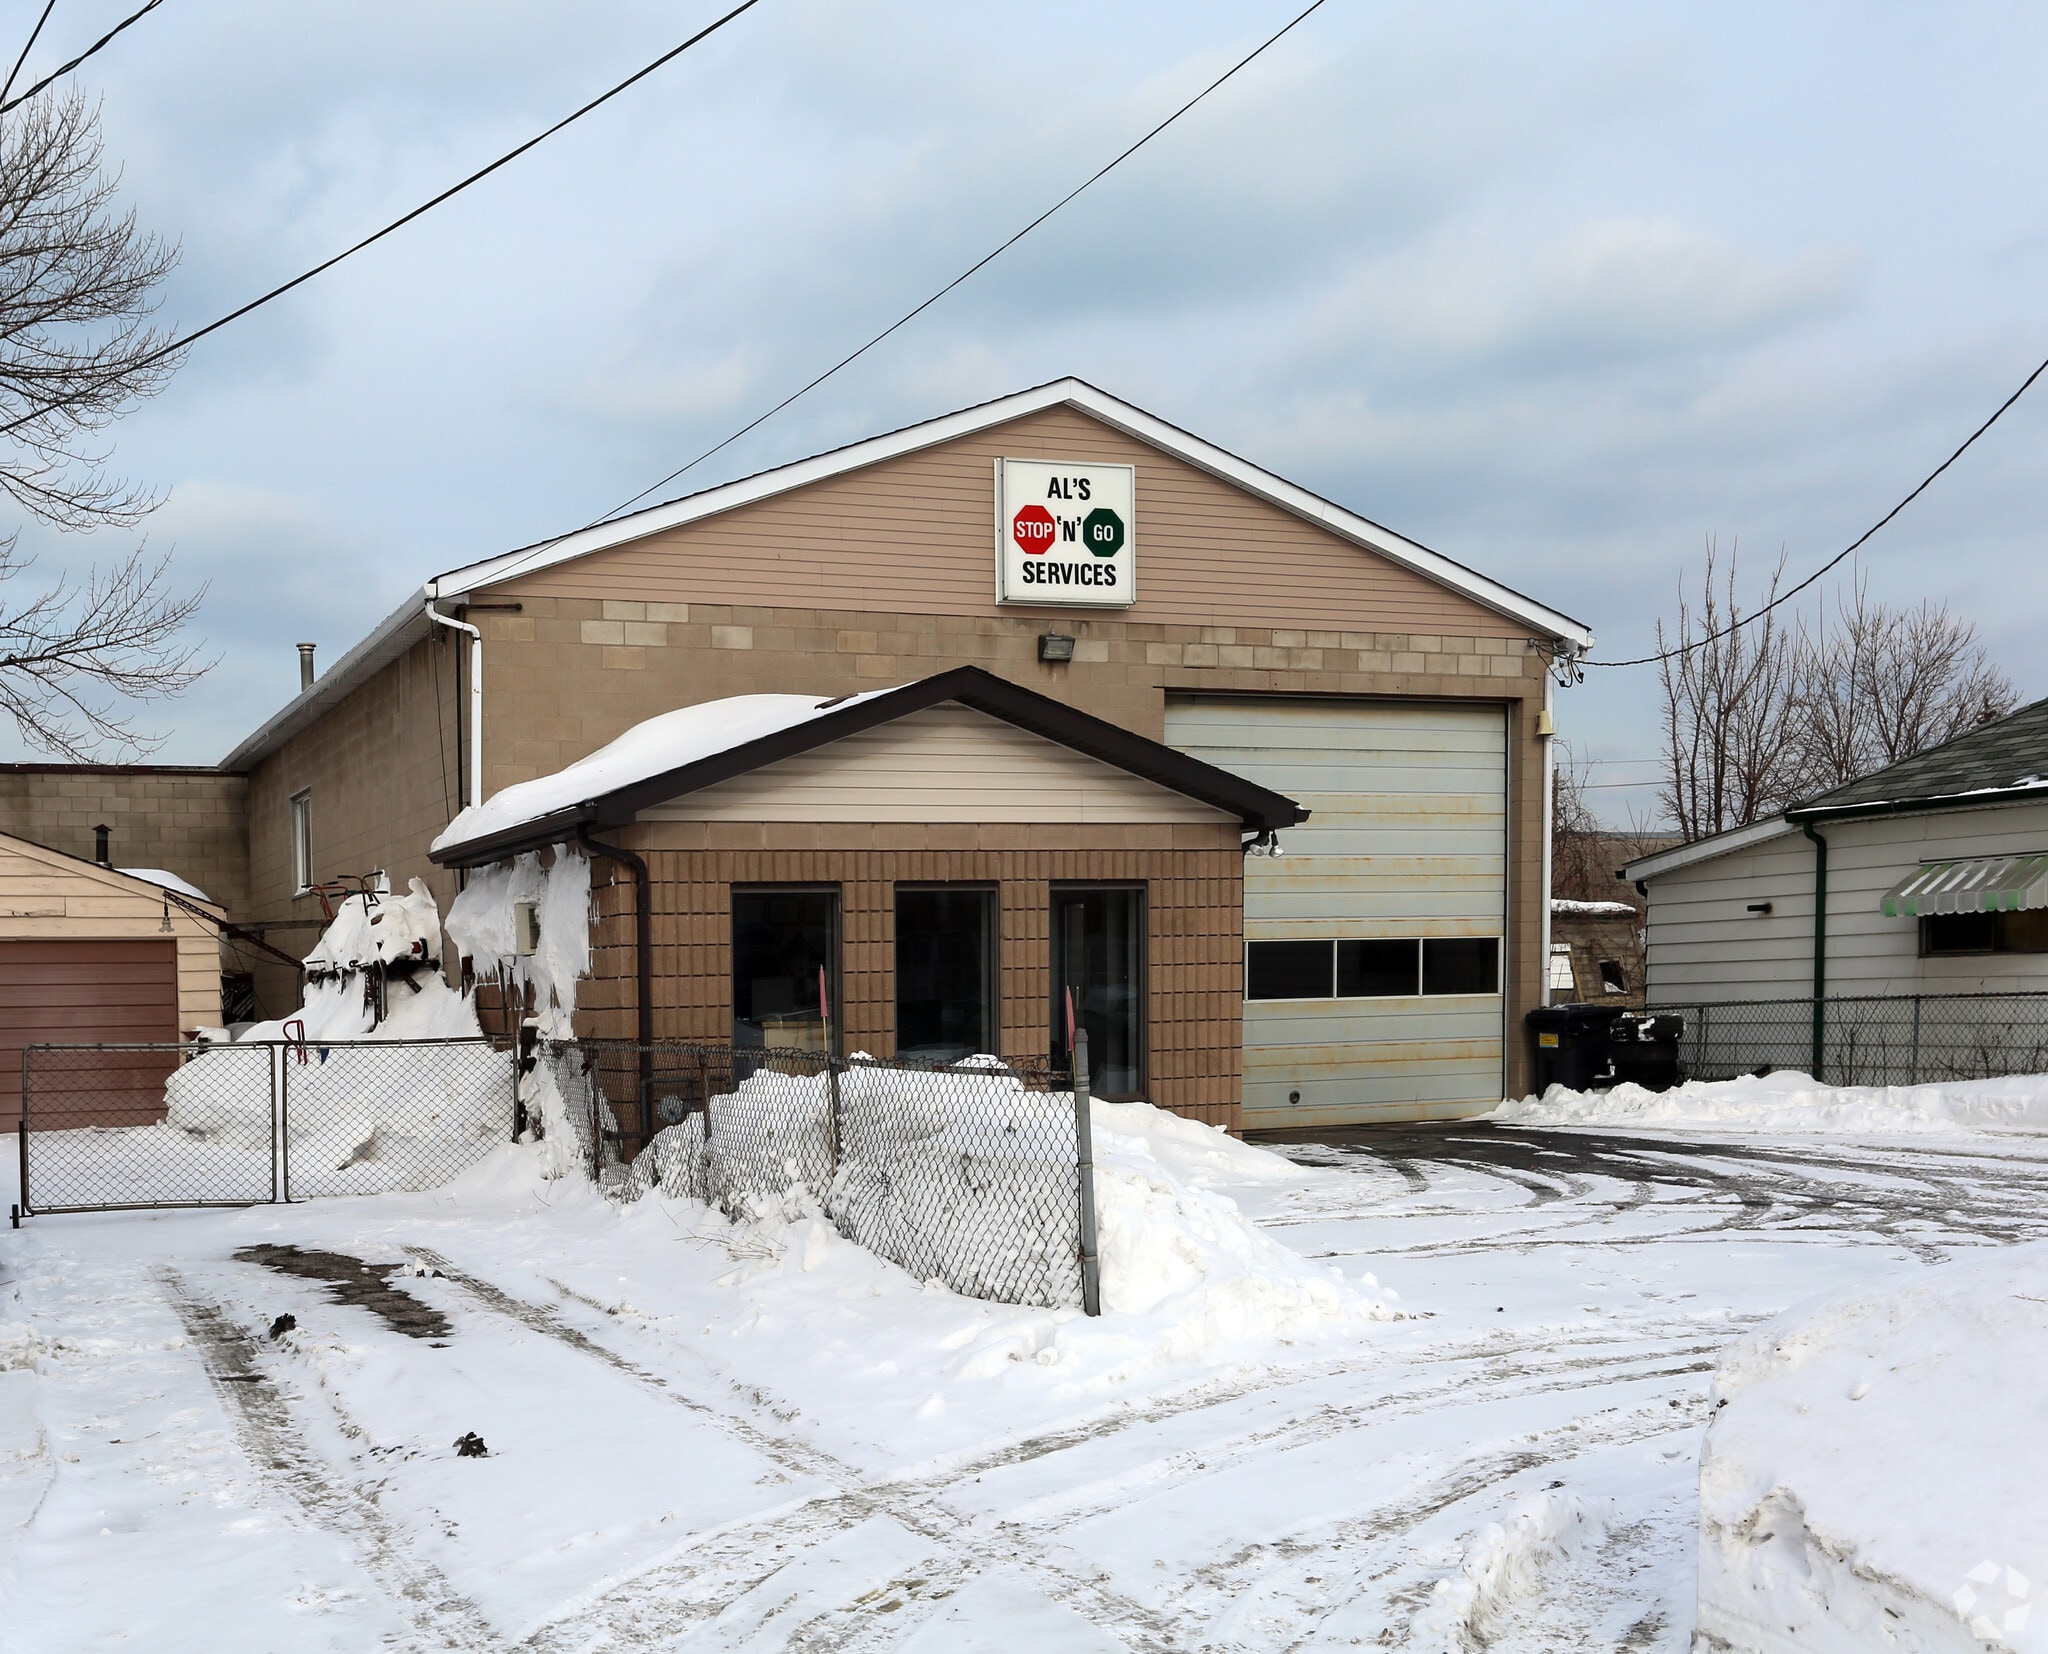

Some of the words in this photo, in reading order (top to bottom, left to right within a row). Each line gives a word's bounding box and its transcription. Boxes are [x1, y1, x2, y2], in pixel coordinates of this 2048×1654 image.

[1047, 477, 1091, 500] AL'S
[1016, 521, 1053, 539] STOP
[1093, 524, 1114, 541] GO
[1022, 561, 1117, 586] SERVICES
